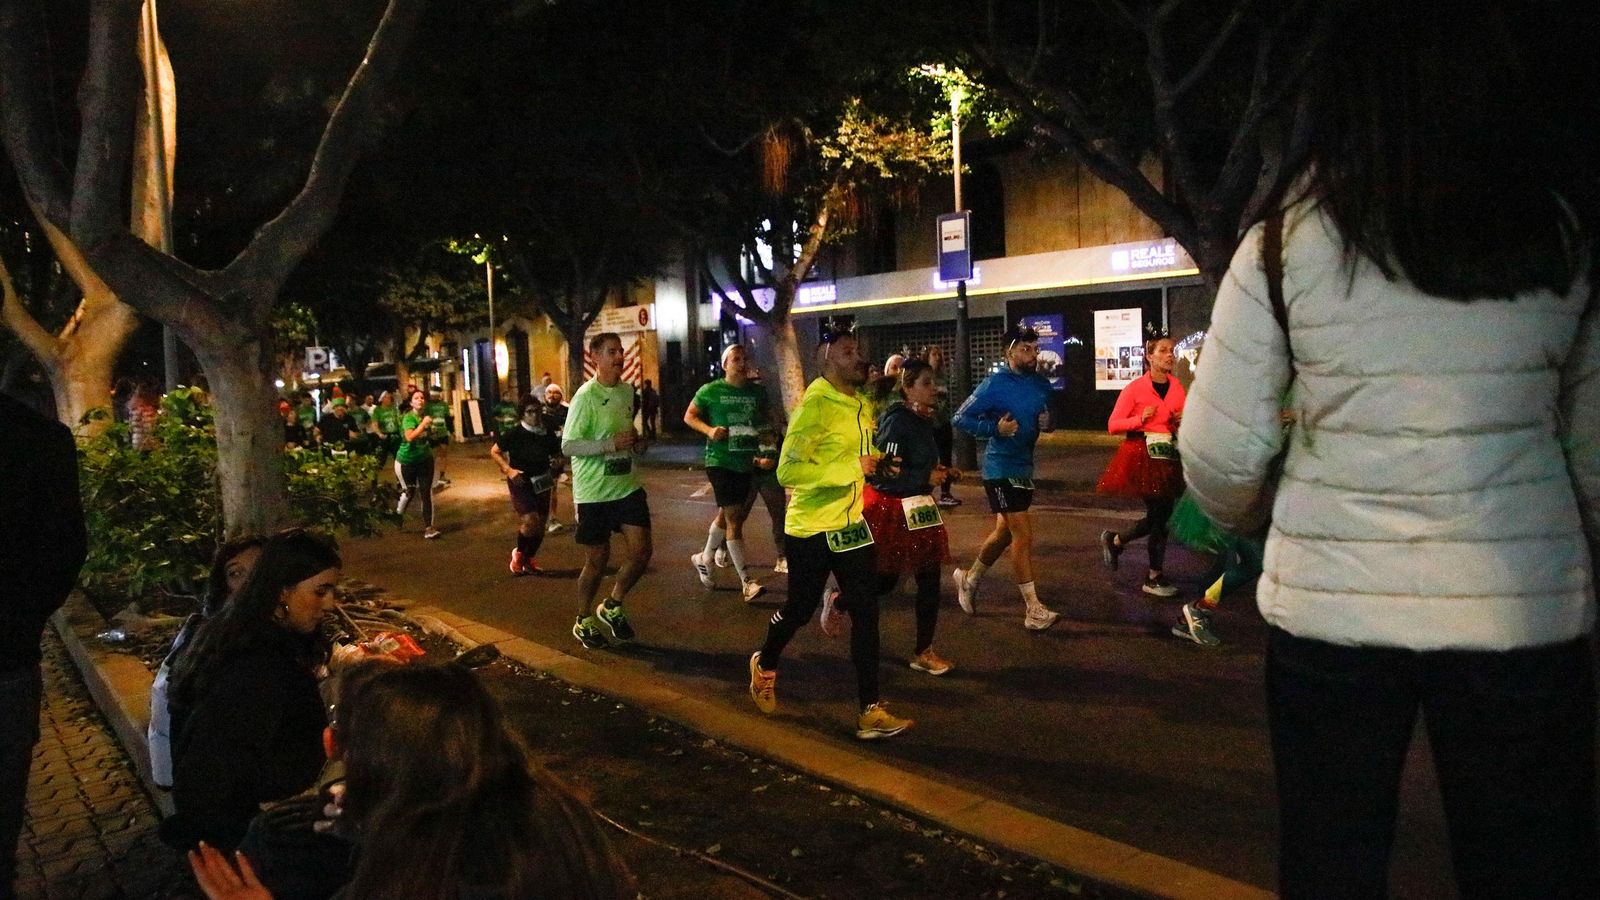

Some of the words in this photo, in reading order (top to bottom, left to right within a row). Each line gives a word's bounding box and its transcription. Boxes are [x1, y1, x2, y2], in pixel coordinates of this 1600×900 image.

[1131, 245, 1175, 261] REALE
[1131, 257, 1175, 268] SEGUROS
[910, 510, 938, 525] 1861
[831, 527, 868, 547] 1530
